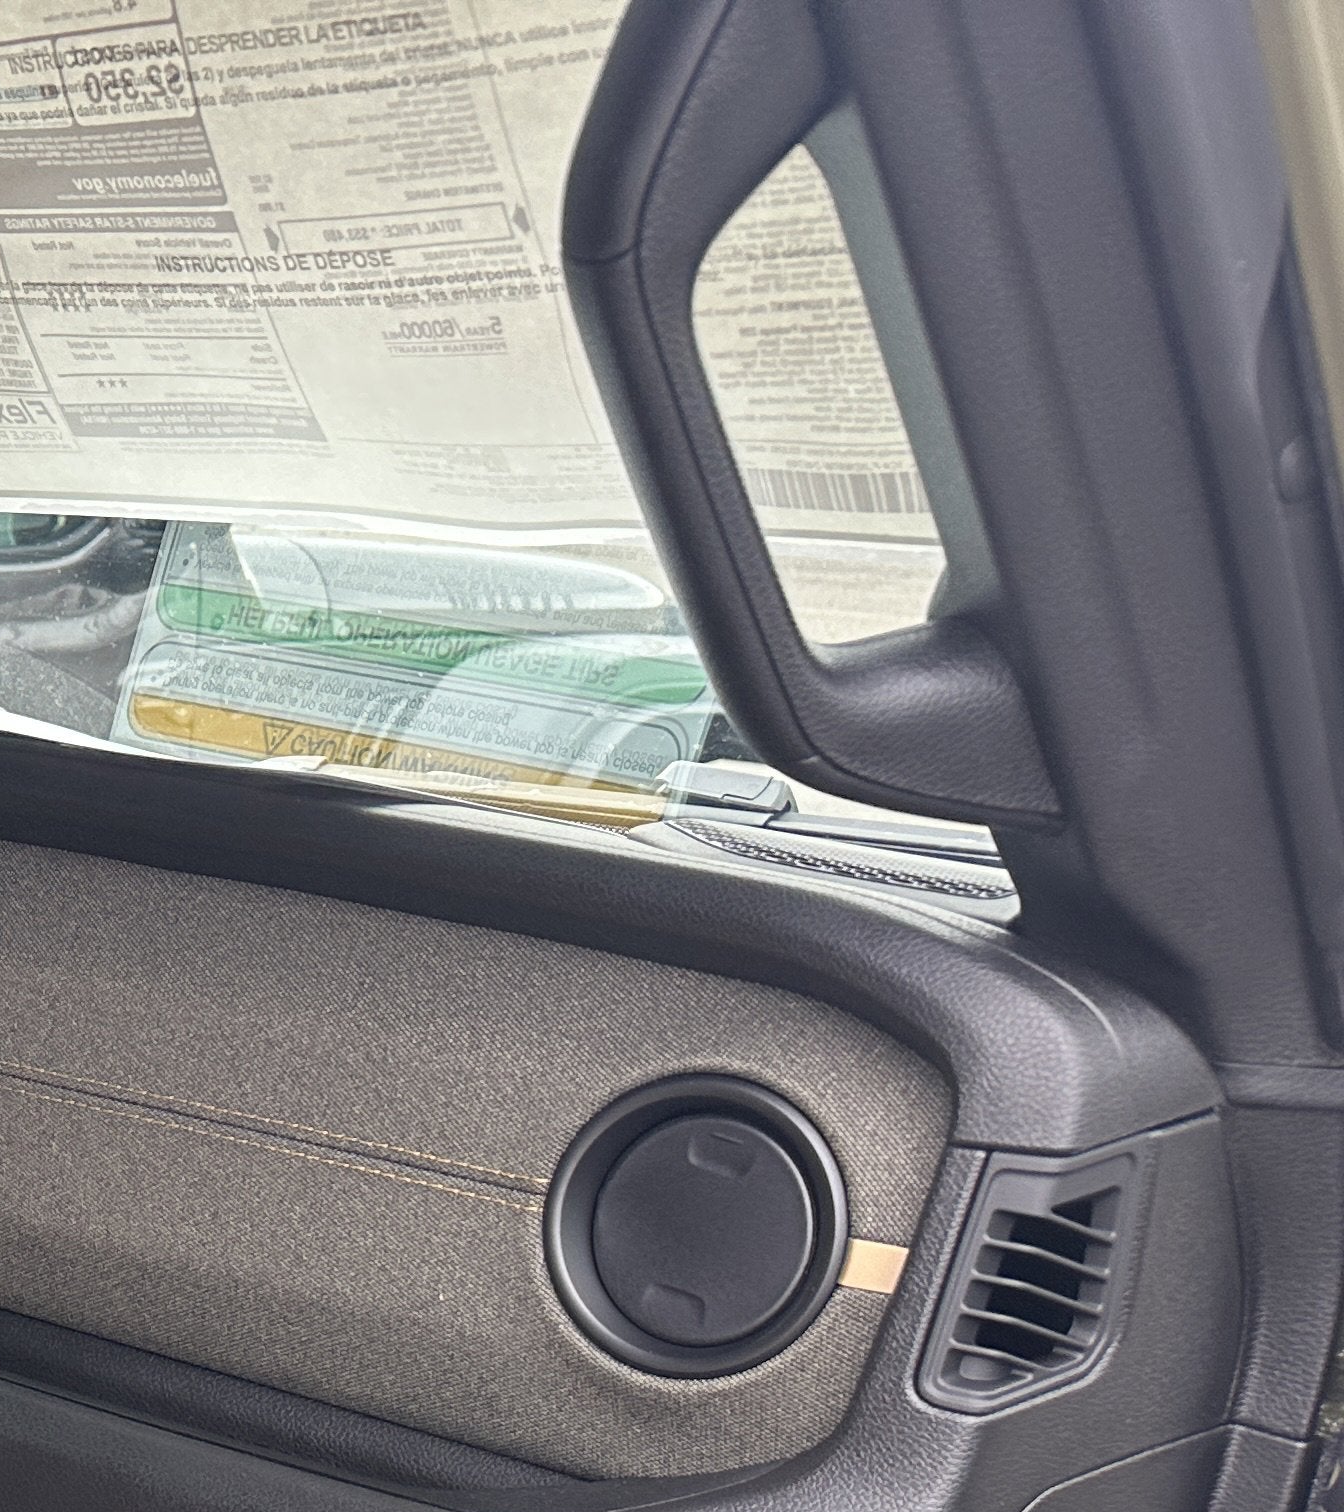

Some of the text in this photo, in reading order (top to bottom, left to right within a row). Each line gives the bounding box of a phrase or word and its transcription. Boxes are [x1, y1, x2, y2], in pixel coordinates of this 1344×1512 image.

[185, 26, 303, 55] DESPRENDER
[304, 23, 331, 44] LA
[331, 11, 426, 42] ETIQUETA
[155, 254, 281, 274] INSTRUCTIONS
[283, 253, 311, 272] DE
[314, 248, 396, 270] DÉPOSE
